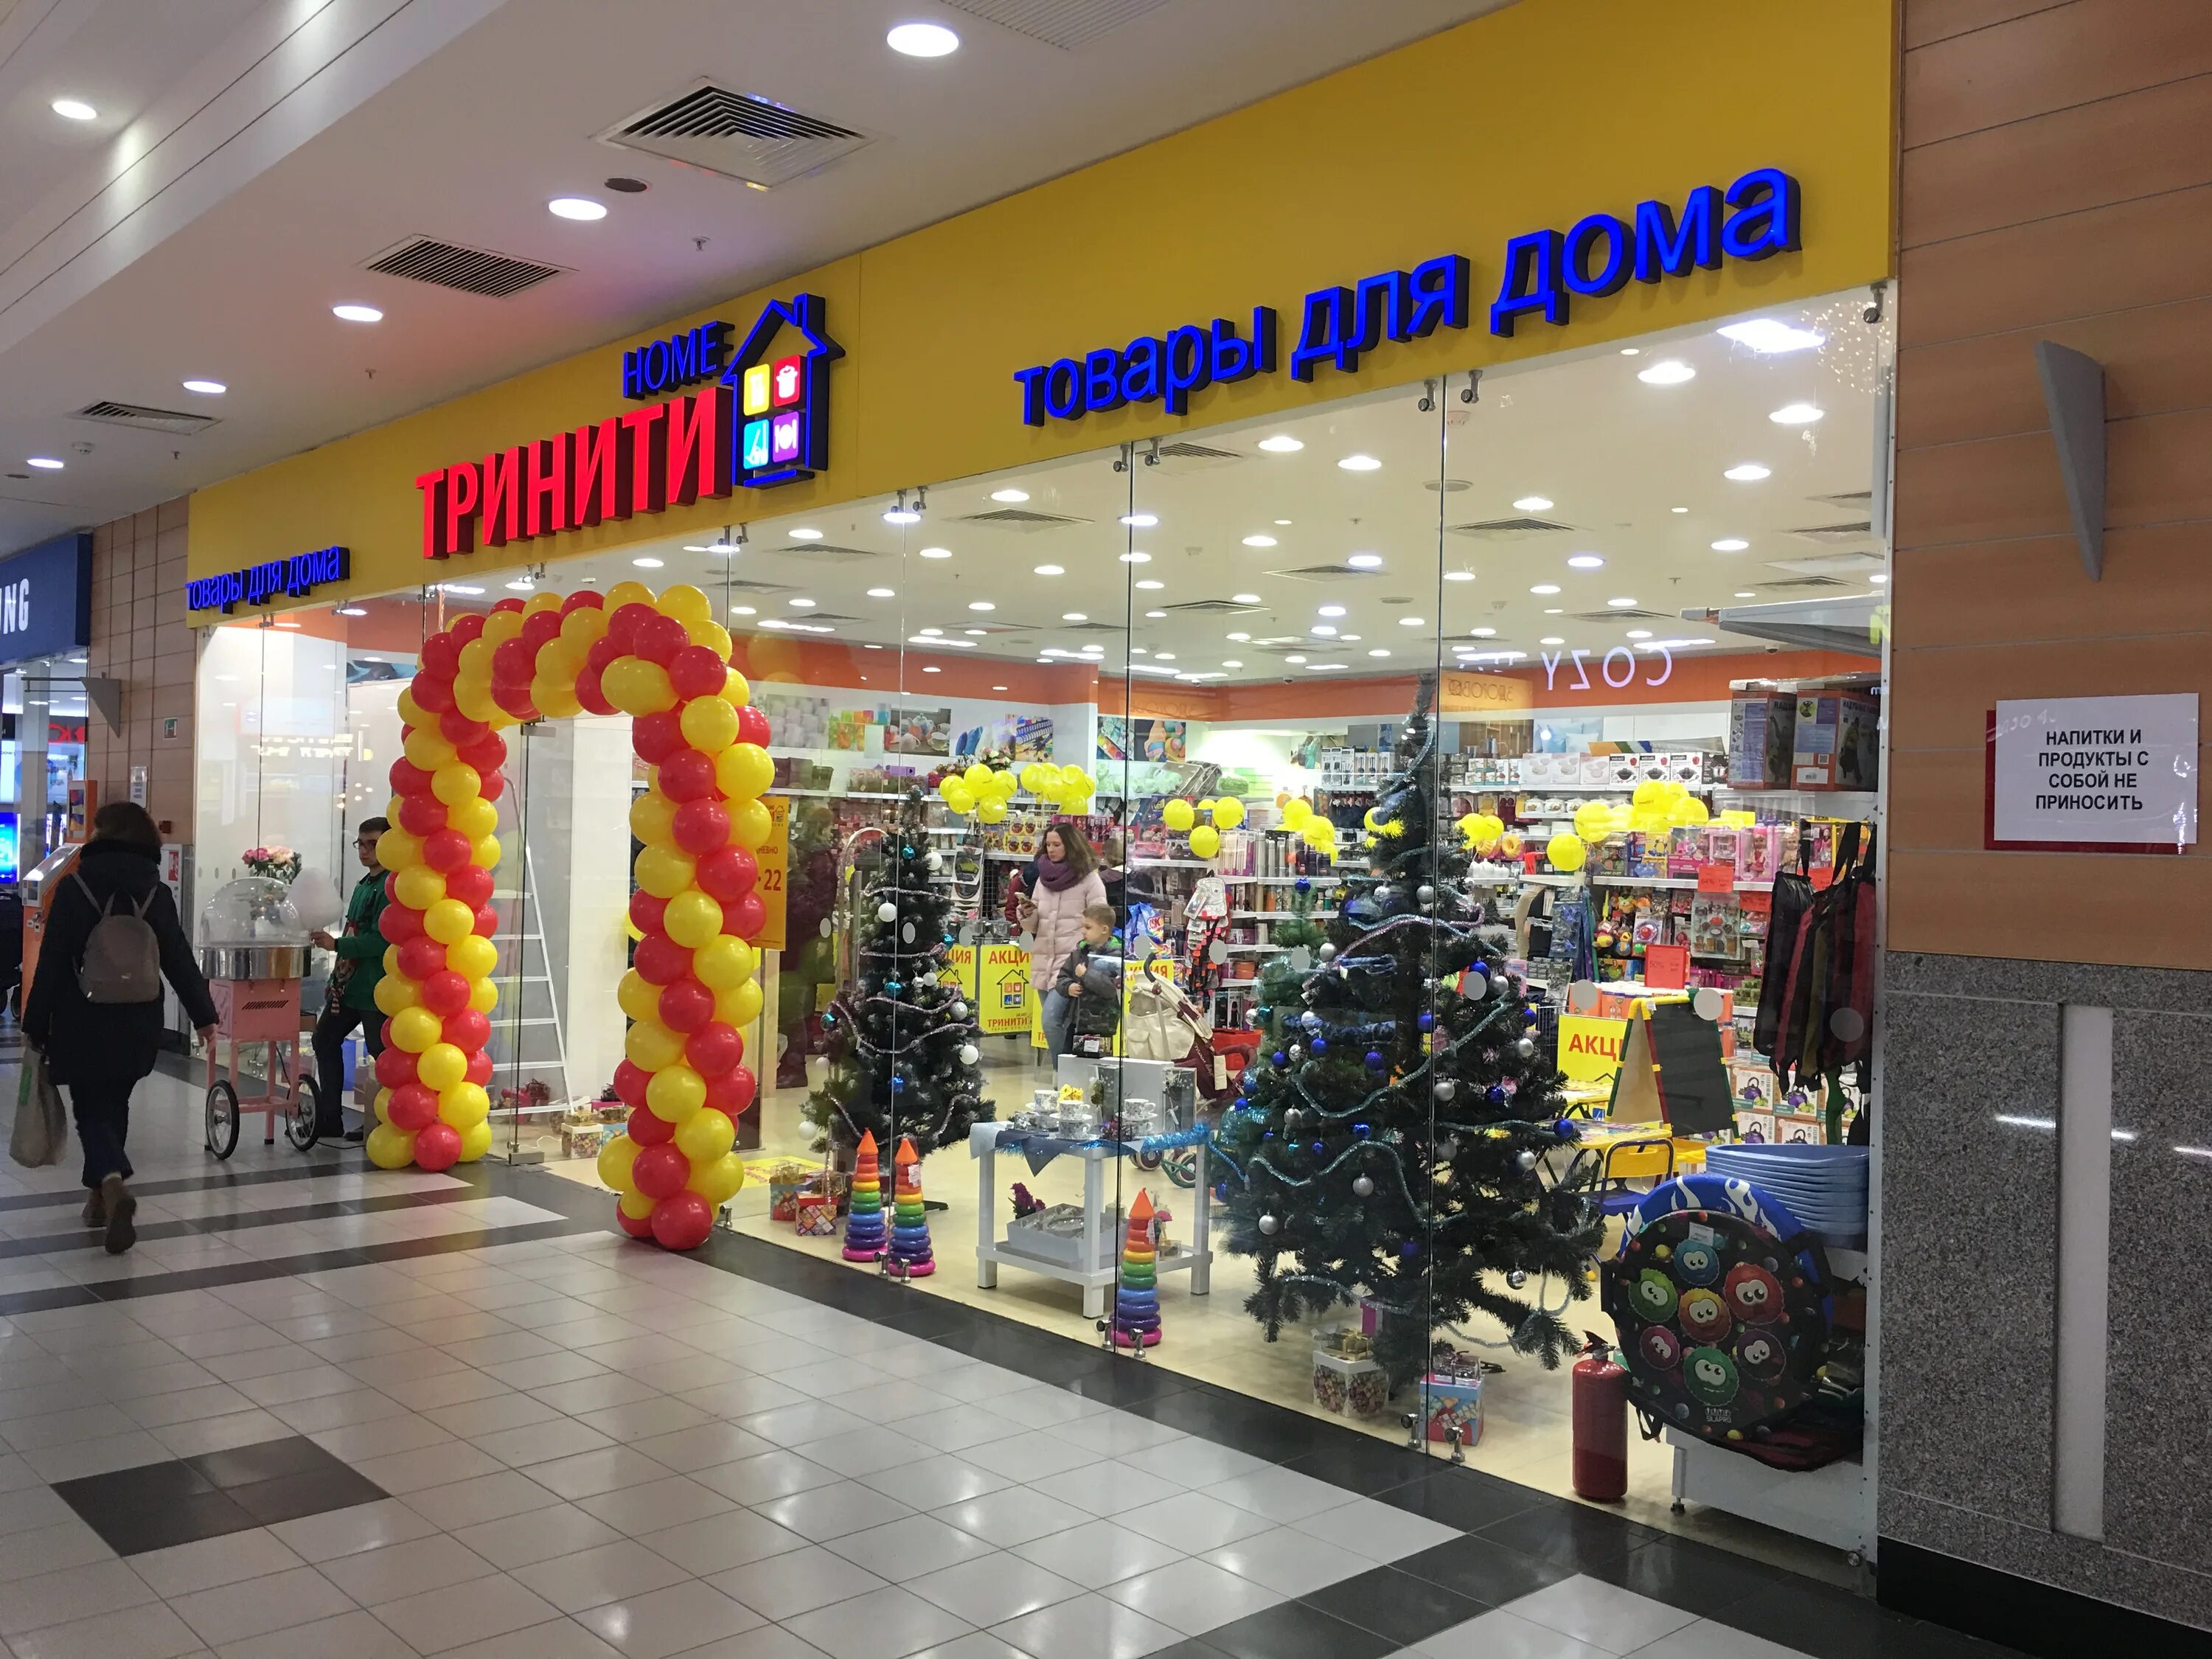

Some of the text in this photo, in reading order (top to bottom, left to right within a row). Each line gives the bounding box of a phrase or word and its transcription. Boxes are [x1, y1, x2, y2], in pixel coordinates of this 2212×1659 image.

[1014, 167, 1802, 427] товары для дома
[622, 320, 730, 400] HOME
[415, 388, 732, 560] ТРИНИТИ
[186, 546, 347, 614] товары для дома
[0, 578, 29, 635] NG
[2046, 728, 2142, 745] НАПИТКИ И
[2039, 751, 2149, 769] ПРОДУКТЫ С
[2048, 770, 2138, 788] СОБОЙ НЕ
[2035, 794, 2143, 810] ПРИНОСИТЬ
[756, 846, 779, 855] НЕВНО
[942, 950, 972, 965] ЦИЯ
[988, 949, 1031, 967] АКЦИ
[987, 1016, 1029, 1028] ТРИНИТИ
[1568, 1034, 1624, 1062] АКЦ
